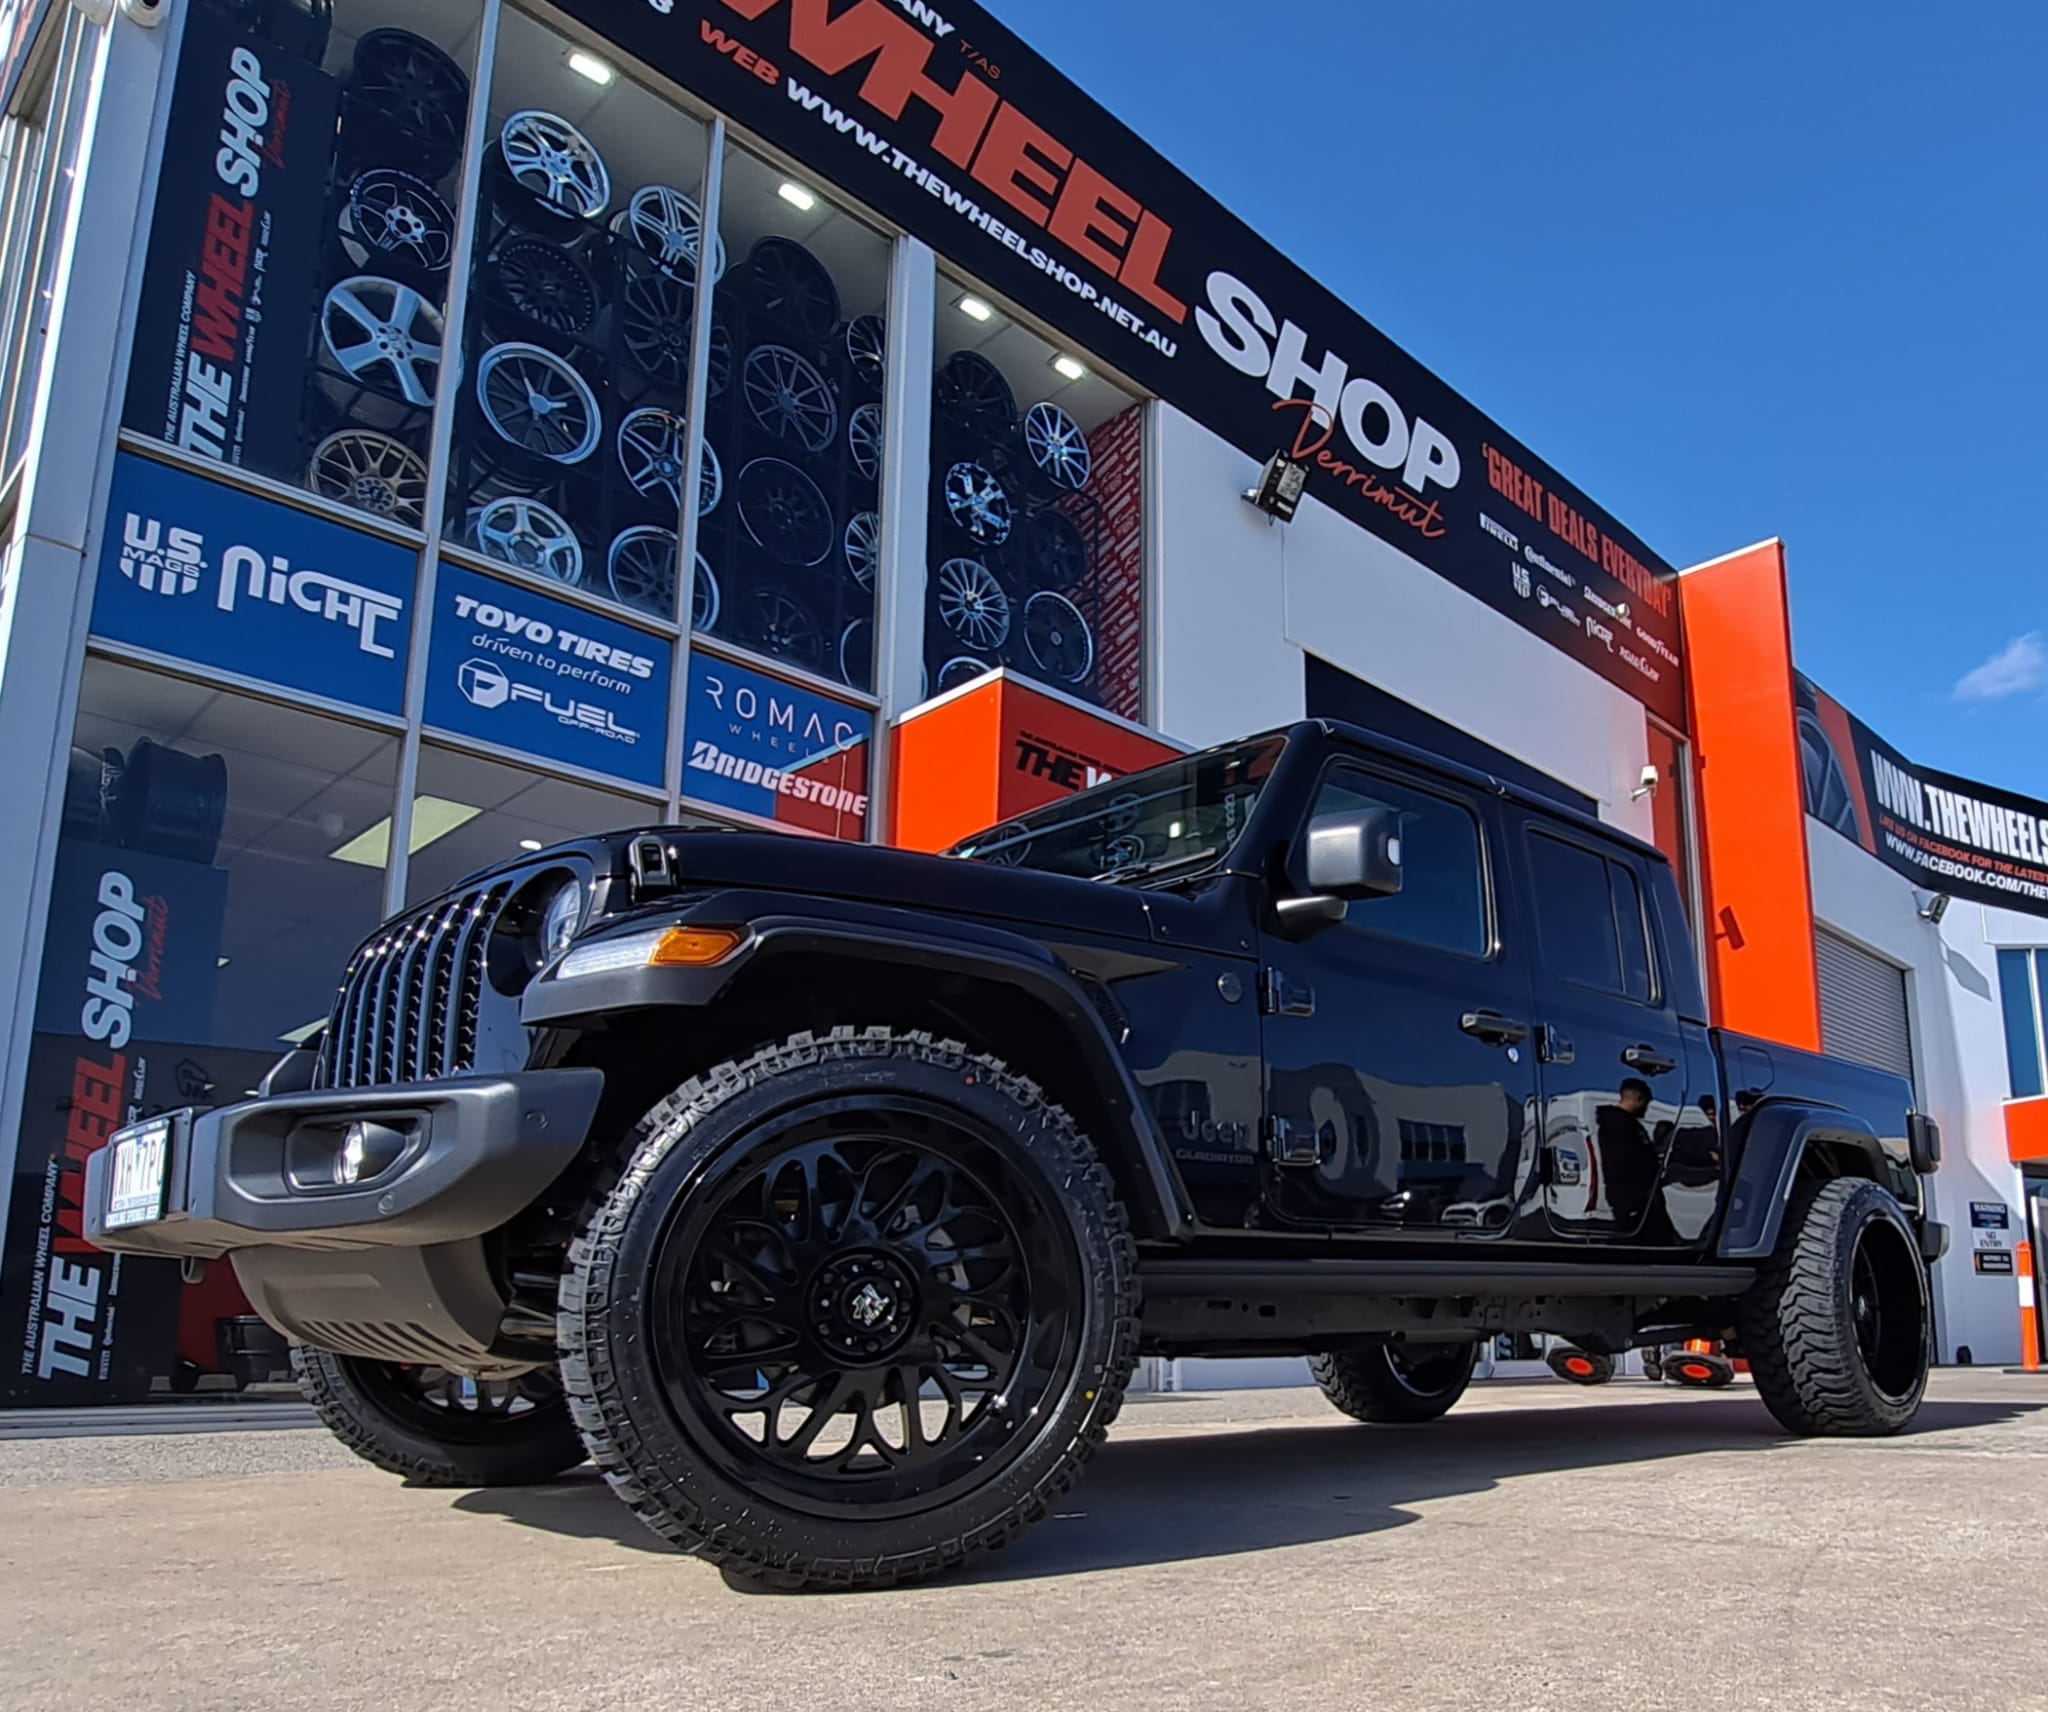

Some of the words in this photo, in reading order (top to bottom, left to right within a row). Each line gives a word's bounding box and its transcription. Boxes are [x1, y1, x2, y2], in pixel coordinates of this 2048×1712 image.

[216, 46, 271, 198] SHOP
[701, 19, 780, 86] WEB
[787, 77, 1178, 359] WWW.THEWHEELSHOP.NET.AU
[191, 192, 255, 362] WHEEL
[719, 0, 1187, 324] WHEEL
[1195, 271, 1461, 494] SHOP
[179, 351, 232, 460] THE
[1271, 399, 1447, 538] Derrimut
[122, 545, 200, 578] MAGS
[1548, 491, 1599, 563] DEALS
[455, 594, 553, 644] TOYO
[557, 630, 654, 679] TIRES
[472, 633, 533, 663] driven
[536, 653, 556, 670] to
[557, 662, 632, 695] perform
[510, 682, 637, 737] FUEL
[557, 715, 637, 745] OFF-ROAD
[705, 675, 853, 751] ROMAC
[687, 740, 869, 817] BRIDGESTONE
[1015, 739, 1085, 791] THE
[1885, 831, 2048, 899] WWW.FACEBOOK.COM/THE
[1919, 836, 1970, 863] FACEBOOK
[1971, 854, 1993, 869] FOR
[1994, 861, 2013, 875] THE
[37, 1256, 101, 1381] THE
[82, 871, 145, 1049] SHOP
[1179, 1109, 1250, 1151] Jeep
[41, 1158, 59, 1224] COMPANY
[35, 1225, 50, 1270] WHEEL
[24, 1270, 46, 1349] AUSTRALIAN
[22, 1348, 35, 1375] THE
